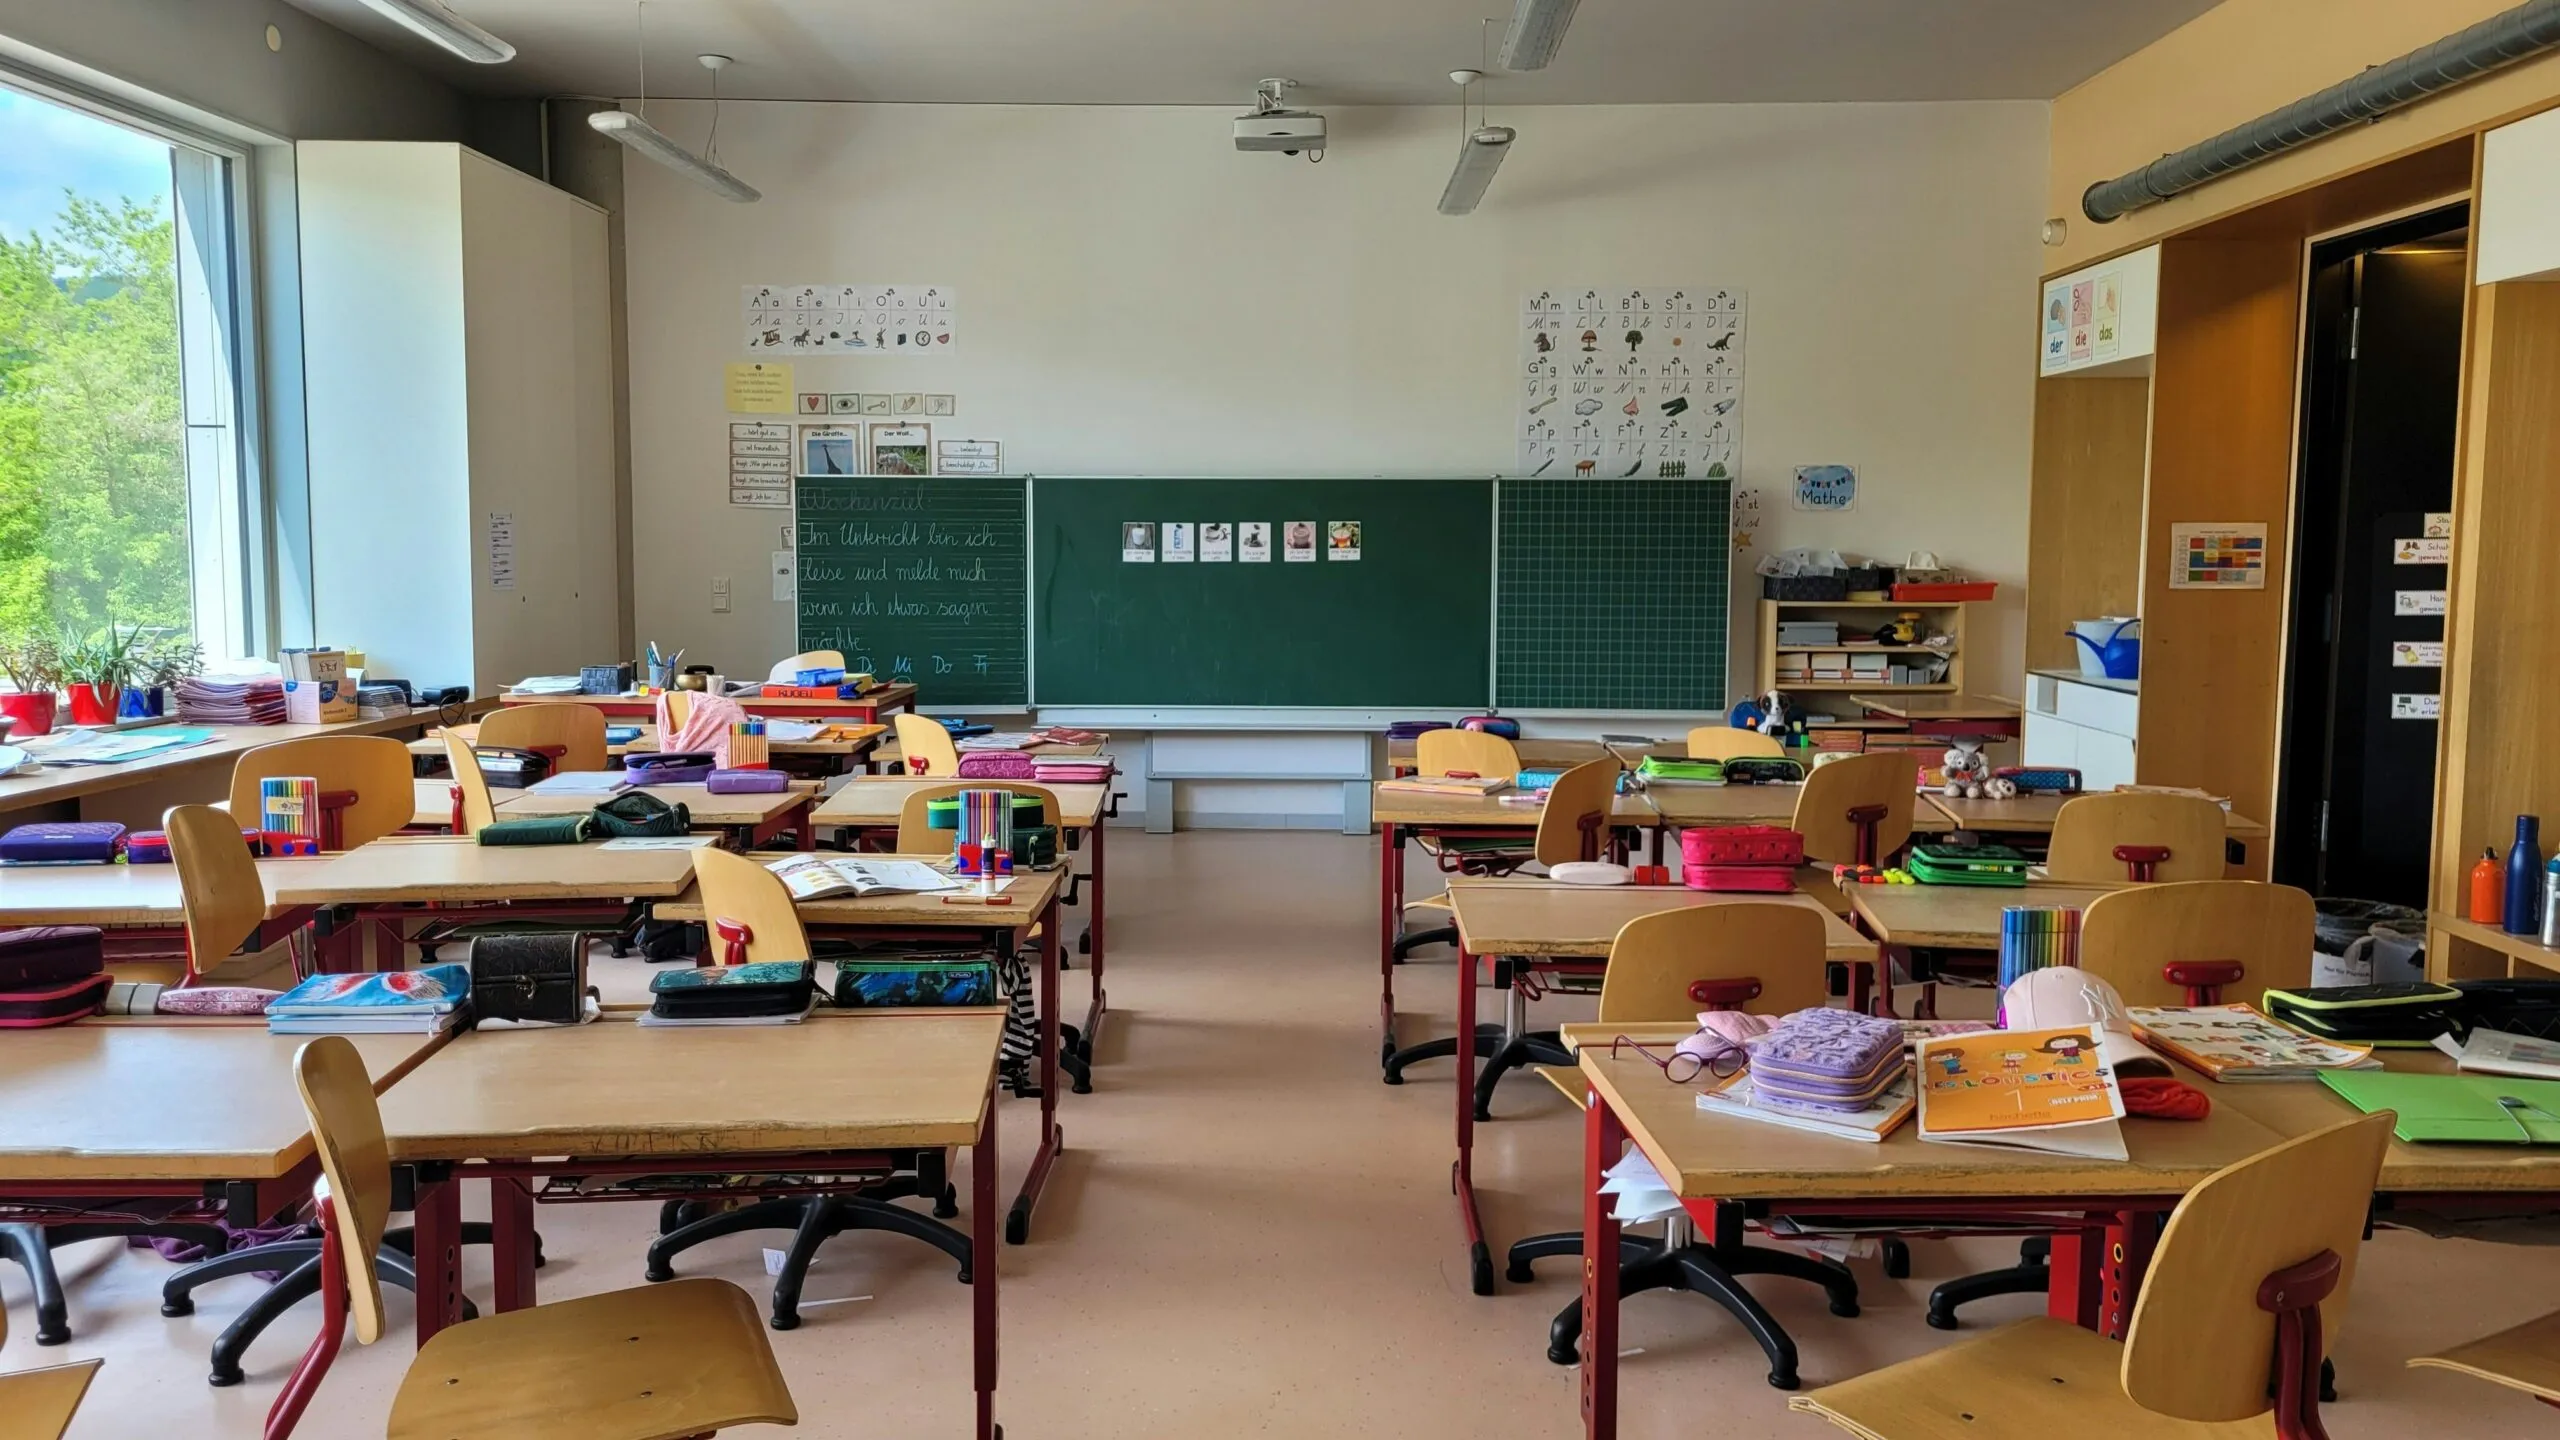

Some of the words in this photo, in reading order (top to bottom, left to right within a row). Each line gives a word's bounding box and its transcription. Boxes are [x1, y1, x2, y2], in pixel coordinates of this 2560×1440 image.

[2076, 329, 2086, 346] die
[2099, 324, 2113, 341] das
[2050, 337, 2063, 353] der
[1802, 491, 1847, 505] Mathe
[801, 522, 831, 547] Im
[840, 521, 919, 546] Unterricht
[927, 521, 958, 546] bin
[965, 522, 997, 547] ich
[804, 557, 845, 581] leise
[855, 557, 888, 581] und
[896, 556, 941, 581] melde
[947, 557, 986, 581] mich
[802, 598, 842, 616] wenn
[850, 592, 879, 616] ich
[888, 591, 929, 616] etwas
[936, 602, 988, 625] sagen
[858, 656, 877, 673] Di
[892, 656, 912, 673] Mi
[931, 655, 952, 674] Do
